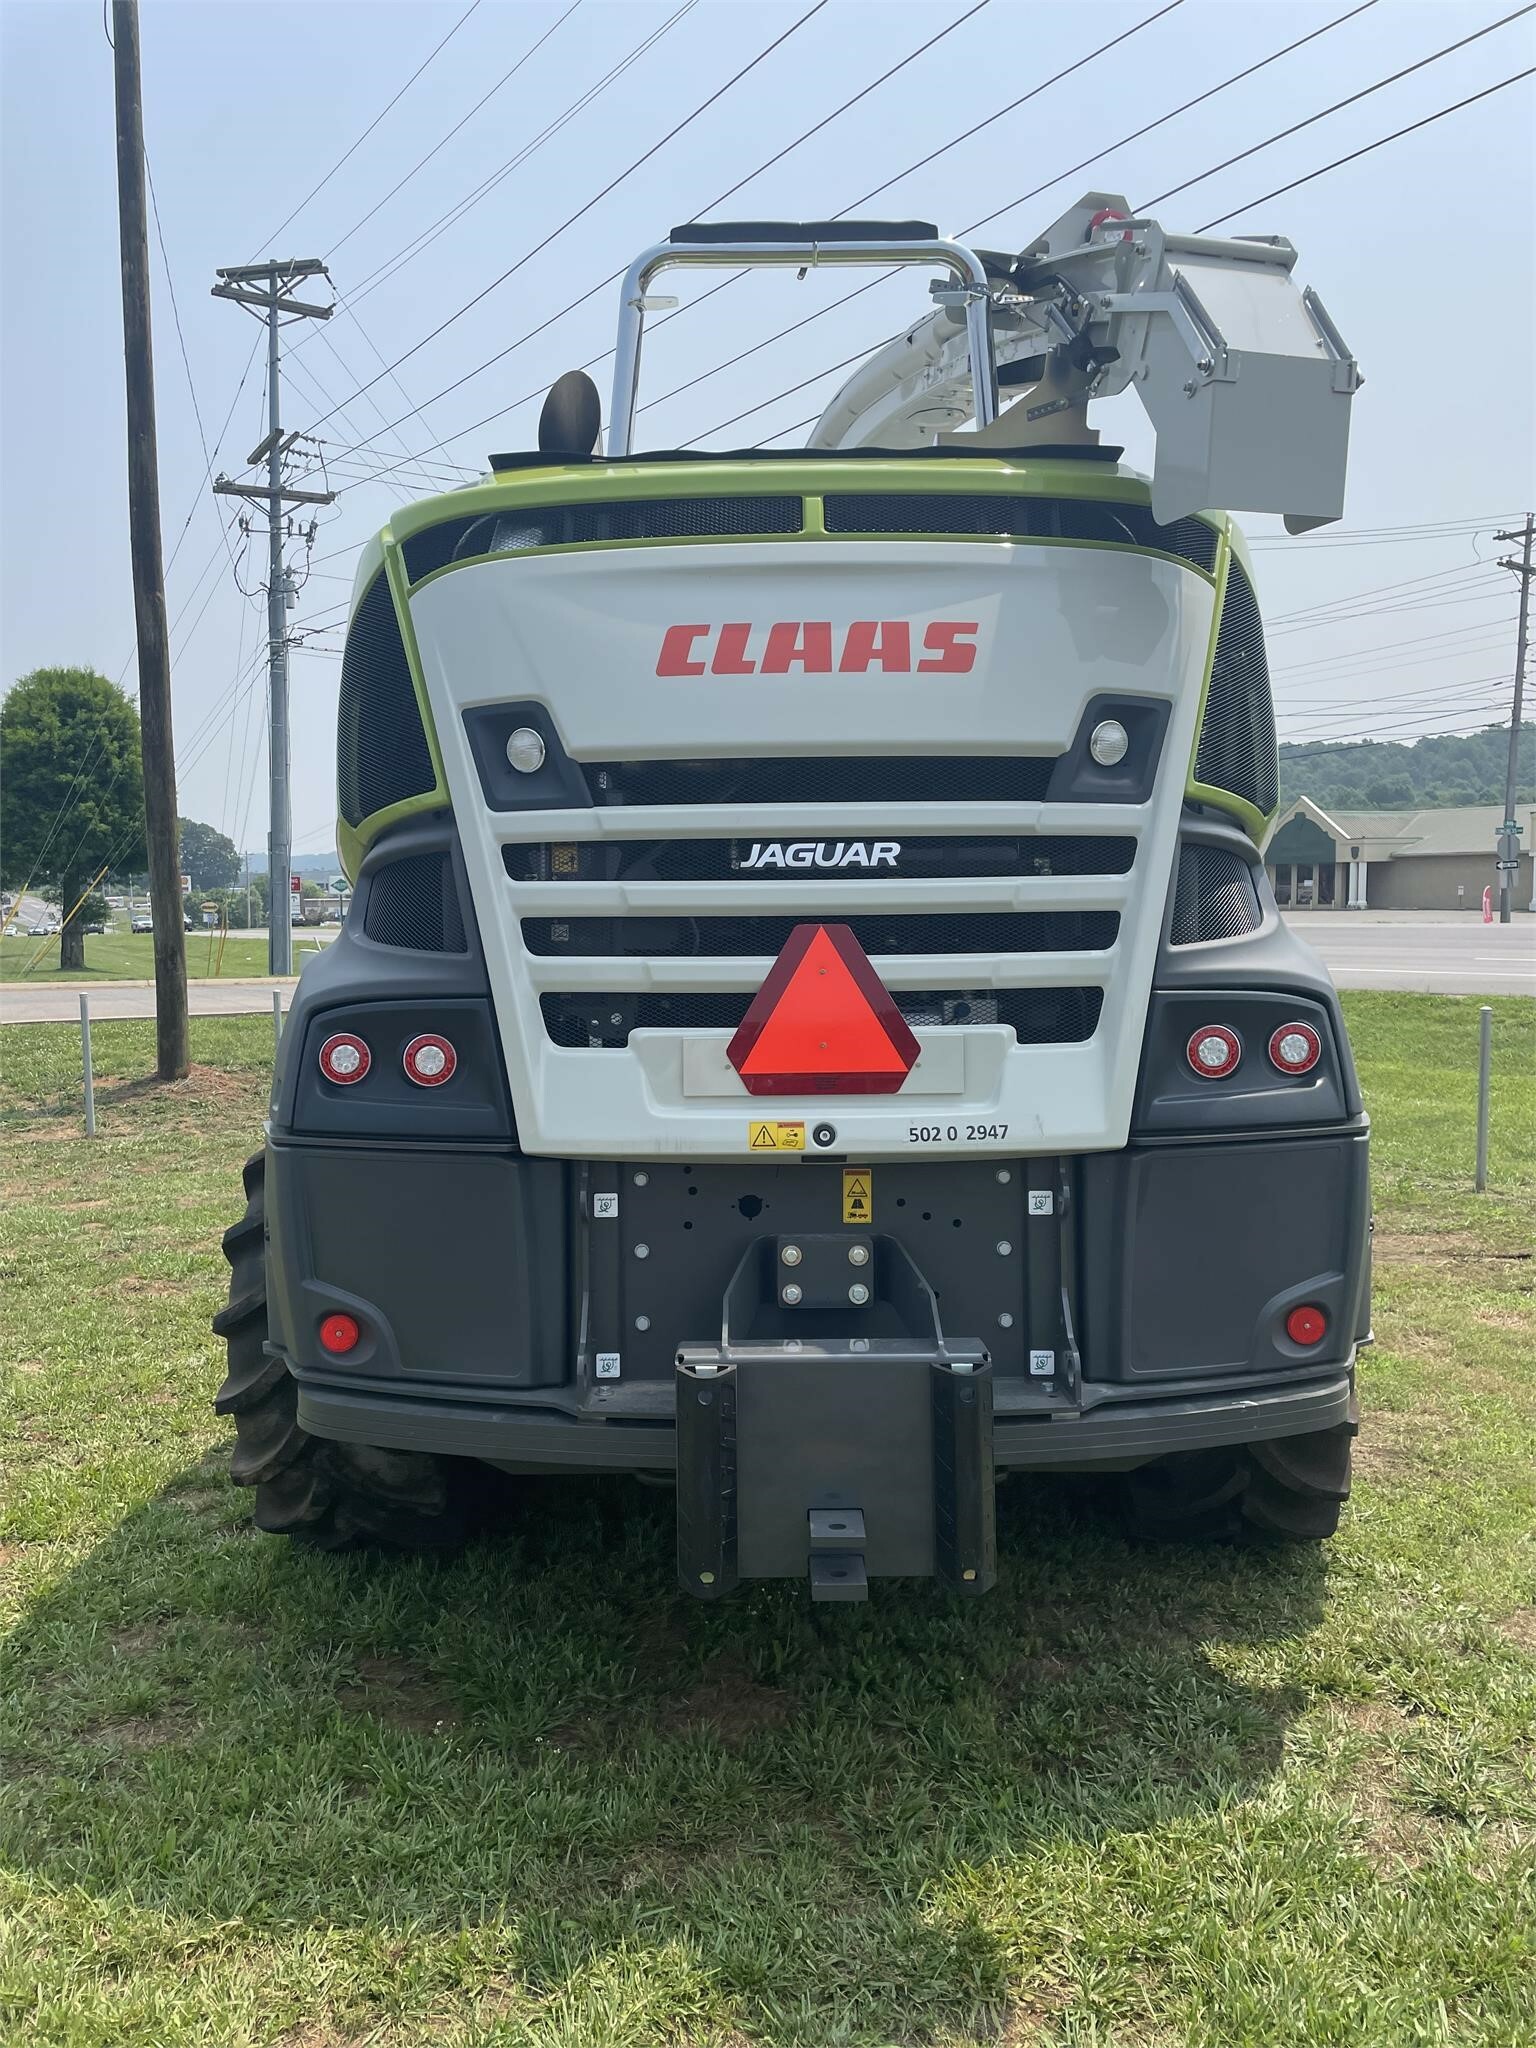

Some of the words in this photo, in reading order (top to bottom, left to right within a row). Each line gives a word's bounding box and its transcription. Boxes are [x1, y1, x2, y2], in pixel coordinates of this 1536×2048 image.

[655, 621, 979, 677] CLAAS
[740, 842, 901, 868] JAGUAR
[909, 1127, 942, 1142] 502
[966, 1124, 1008, 1140] 2947
